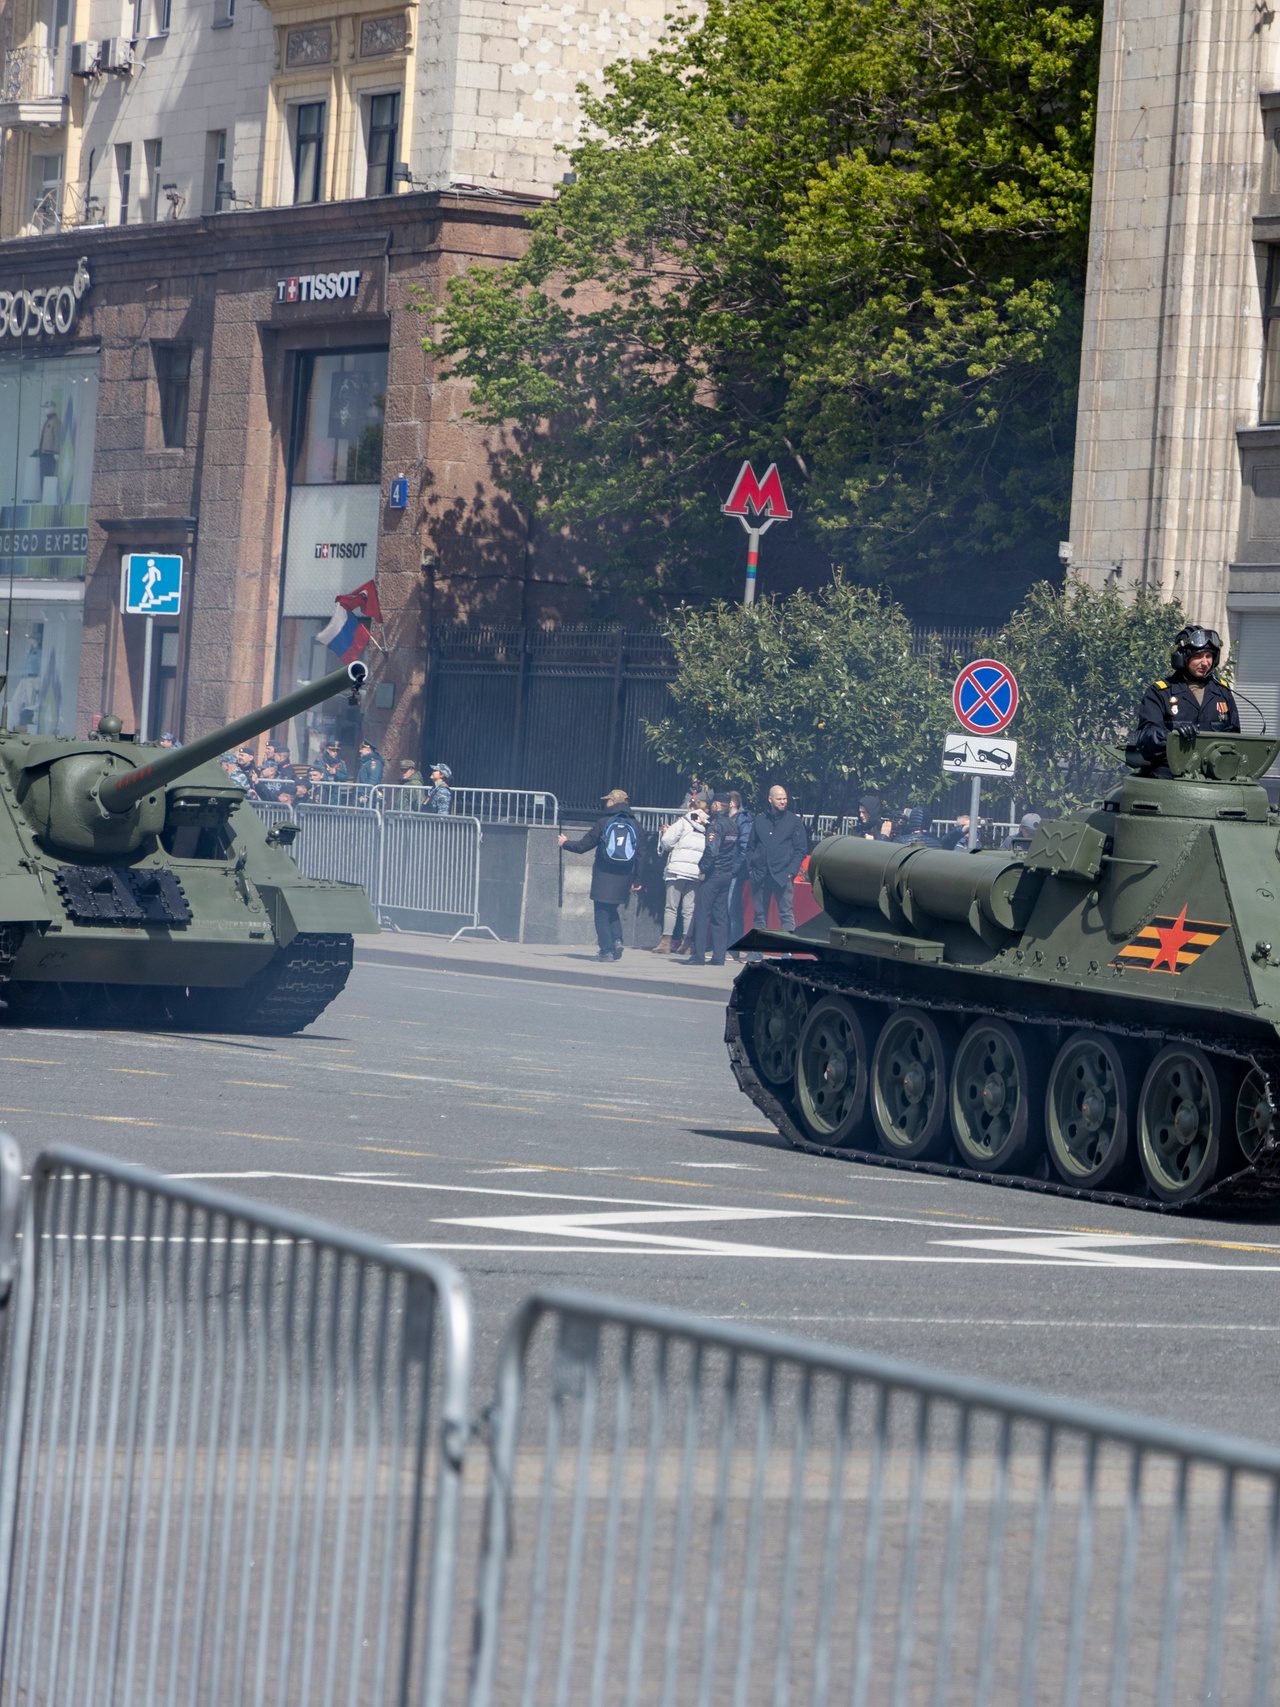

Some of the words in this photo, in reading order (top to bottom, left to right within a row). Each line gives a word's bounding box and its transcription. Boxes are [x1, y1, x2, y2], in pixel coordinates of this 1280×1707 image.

[298, 270, 360, 301] TISSOT
[392, 484, 400, 503] 4
[45, 533, 89, 552] EXPED
[329, 543, 367, 559] TISSOT
